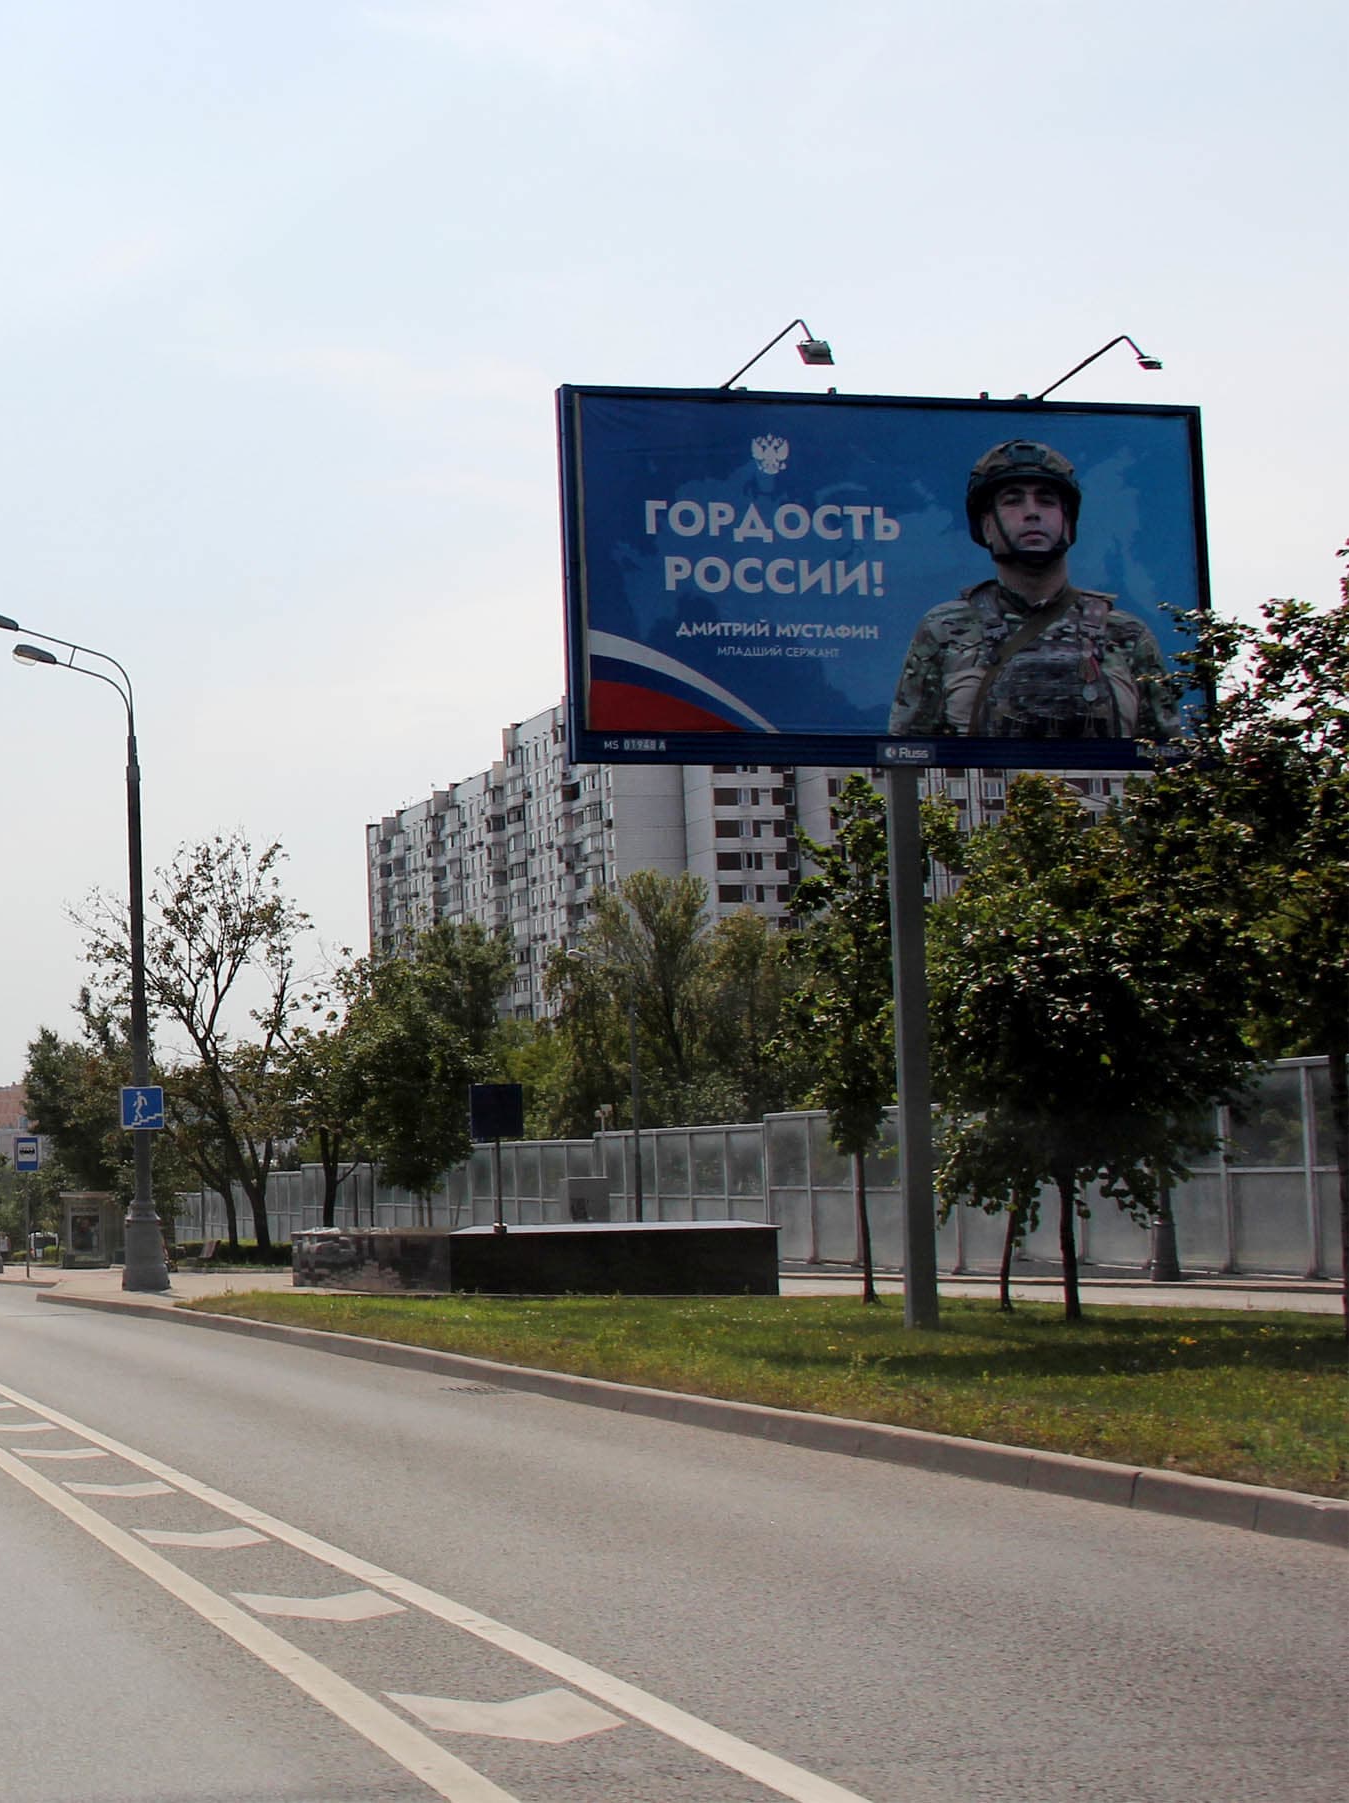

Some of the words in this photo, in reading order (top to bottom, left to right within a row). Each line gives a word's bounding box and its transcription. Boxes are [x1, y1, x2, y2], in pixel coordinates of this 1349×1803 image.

[645, 500, 900, 543] ГОРДОСТЬ
[664, 556, 884, 597] РОССИИ!
[676, 619, 769, 639] ДМИТРИЙ
[776, 623, 878, 640] МУСТАФИН
[717, 645, 782, 658] МЛАДШИЙ
[785, 647, 839, 659] СЕРЖАНТ
[604, 740, 619, 750] MS
[898, 747, 929, 759] Russ
